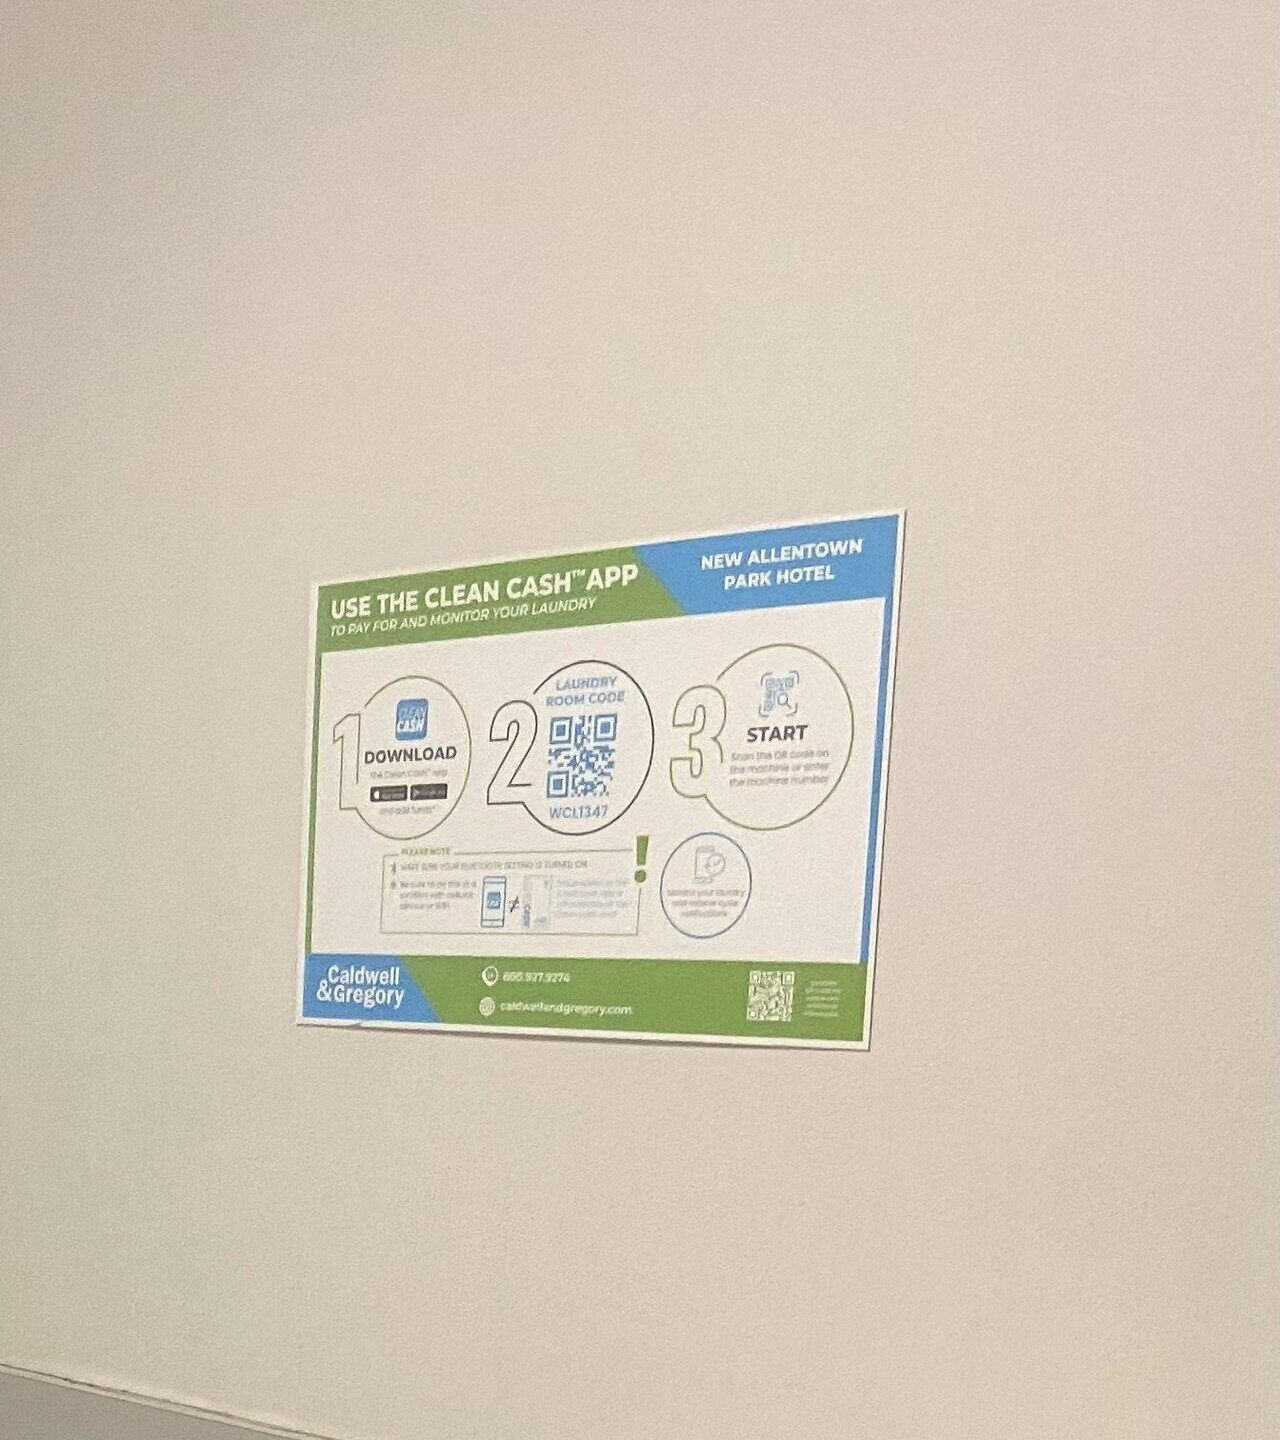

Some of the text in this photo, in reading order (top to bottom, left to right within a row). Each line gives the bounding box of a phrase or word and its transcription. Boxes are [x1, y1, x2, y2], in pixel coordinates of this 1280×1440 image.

[701, 538, 864, 571] NEW ALLENTOWN
[723, 564, 836, 591] PARK HOTEL
[330, 595, 371, 619] USE
[376, 589, 419, 614] THE
[424, 579, 500, 609] CLEAN
[586, 563, 639, 591] APP
[329, 597, 598, 637] TO PAY FOR AND MONITOR YOUR LAUNDRY
[555, 676, 618, 691] LAUNDRY
[546, 691, 625, 708] ROOM CODE
[746, 724, 809, 743] START
[364, 745, 457, 764] DOWNLOAD
[327, 964, 400, 986] Caldwell
[316, 979, 405, 1009] &Gregory
